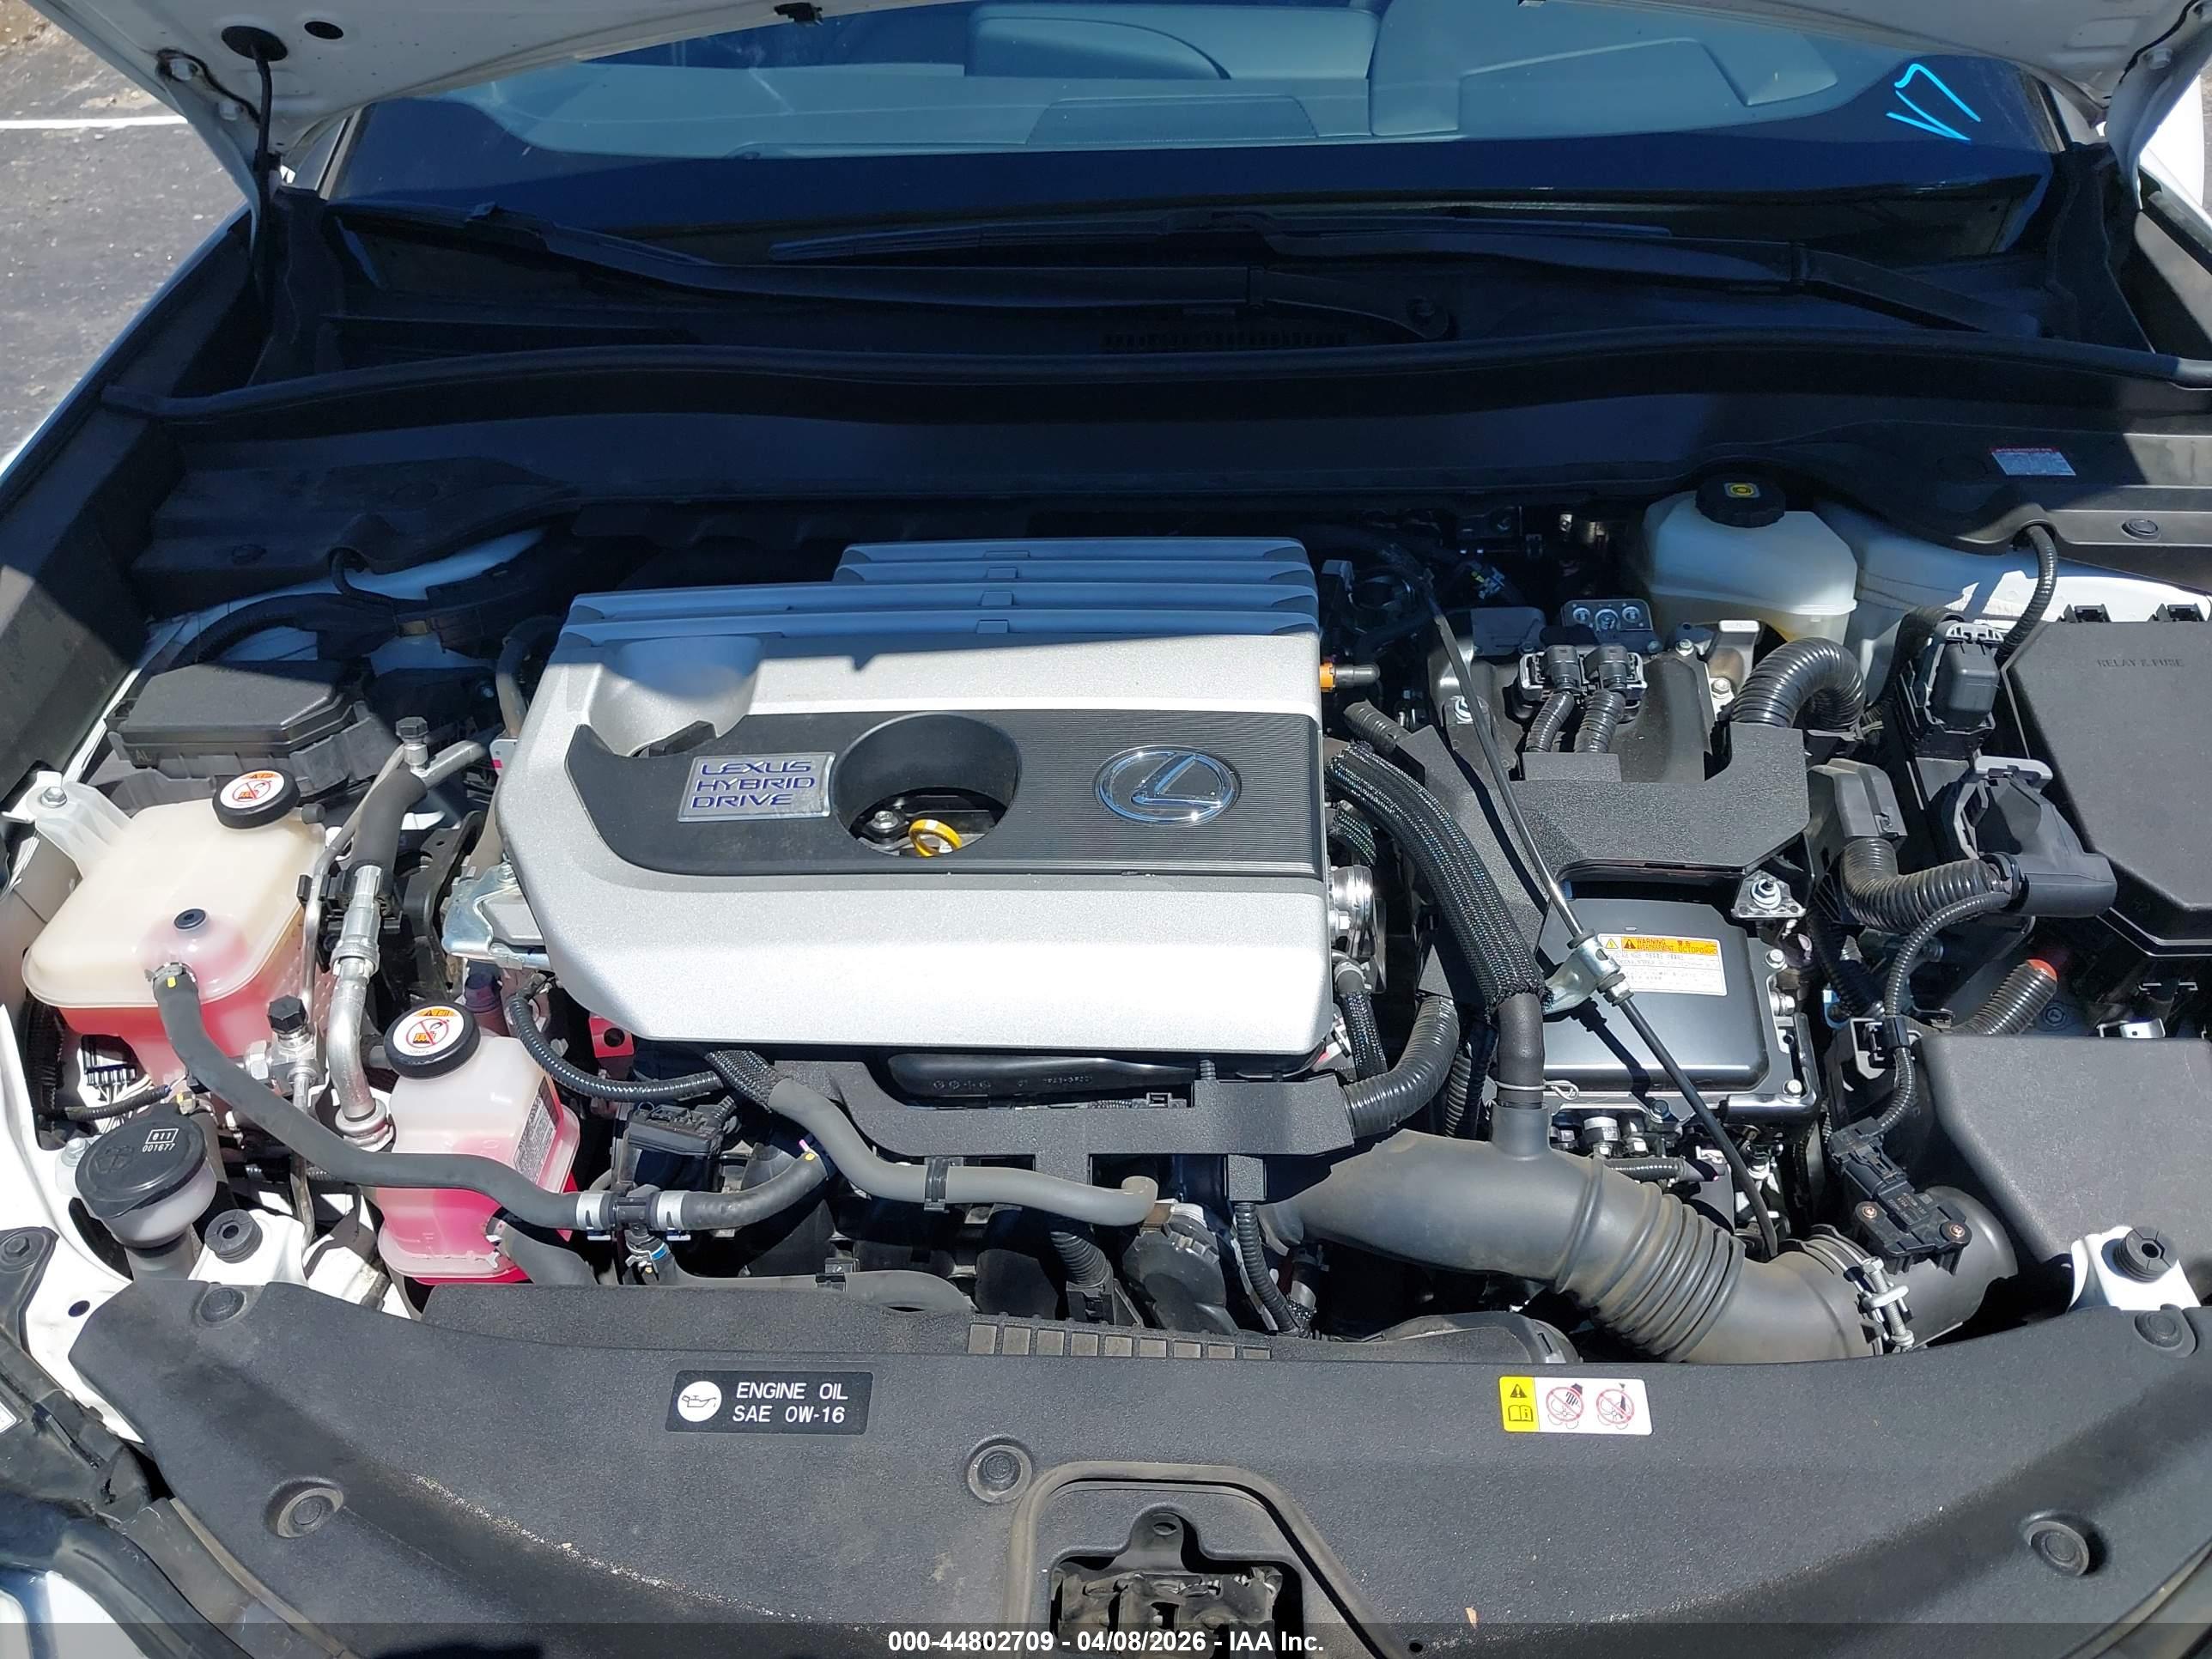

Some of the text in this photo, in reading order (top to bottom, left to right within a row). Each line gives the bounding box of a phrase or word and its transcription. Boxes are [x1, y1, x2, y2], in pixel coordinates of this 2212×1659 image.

[700, 761, 812, 776] LEXUS
[696, 776, 816, 792] HYBRID
[690, 793, 794, 809] DRIVE
[1636, 937, 1666, 945] WARNING
[142, 1143, 176, 1152] 001677
[736, 1382, 848, 1401] ENGINE OIL
[732, 1405, 846, 1424] SAE 0W-16
